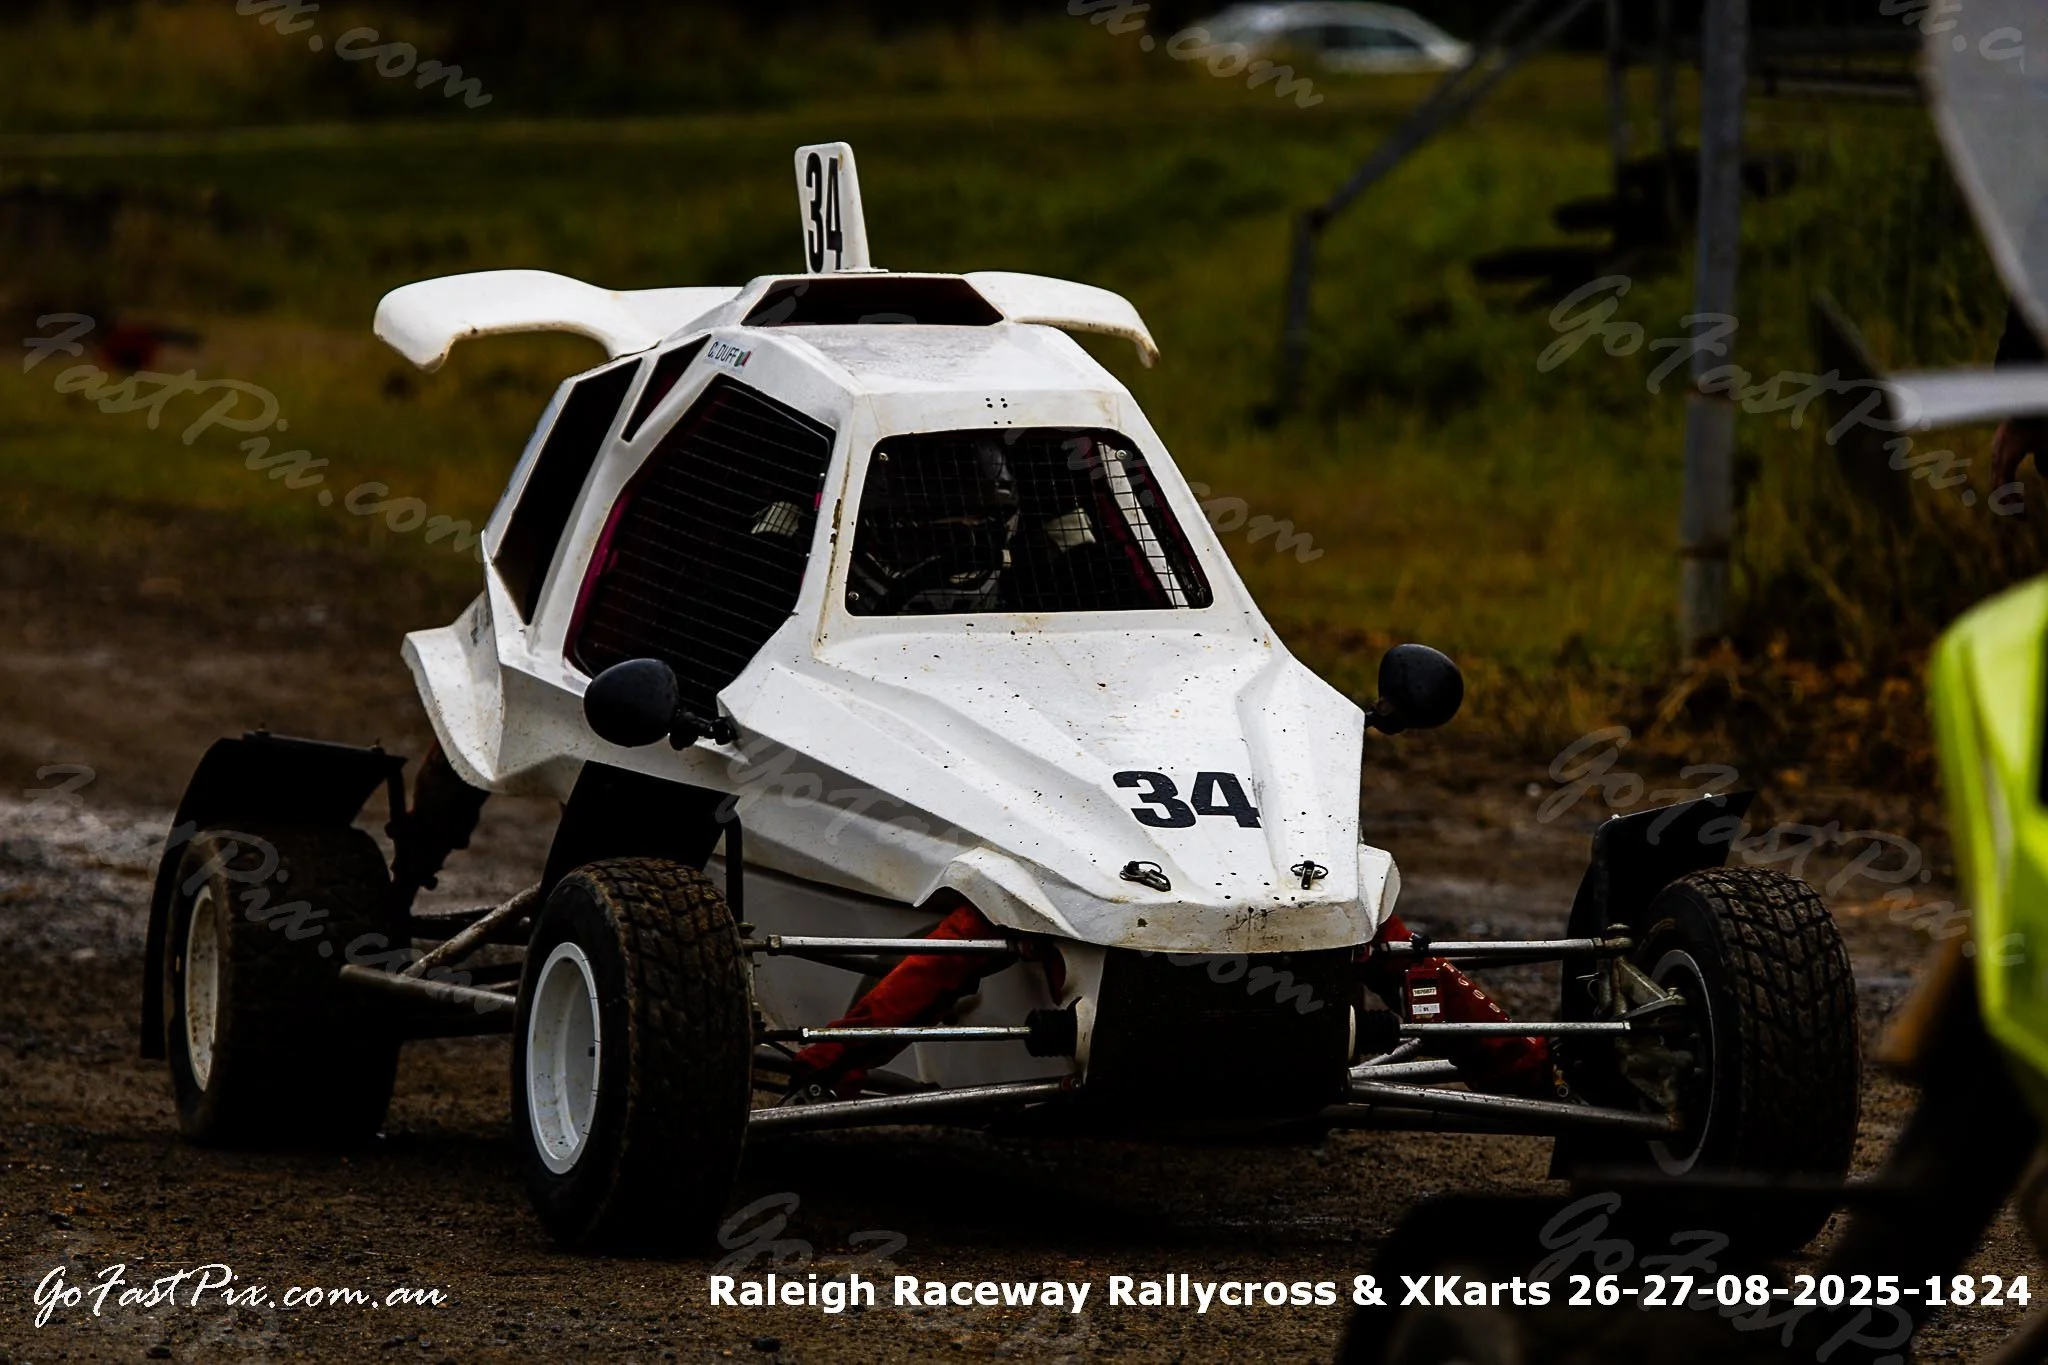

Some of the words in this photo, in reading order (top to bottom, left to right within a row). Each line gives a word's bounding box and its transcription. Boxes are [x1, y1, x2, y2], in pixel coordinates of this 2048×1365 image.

[806, 152, 842, 273] 34
[715, 344, 740, 363] DUFF
[1113, 771, 1261, 829] 34
